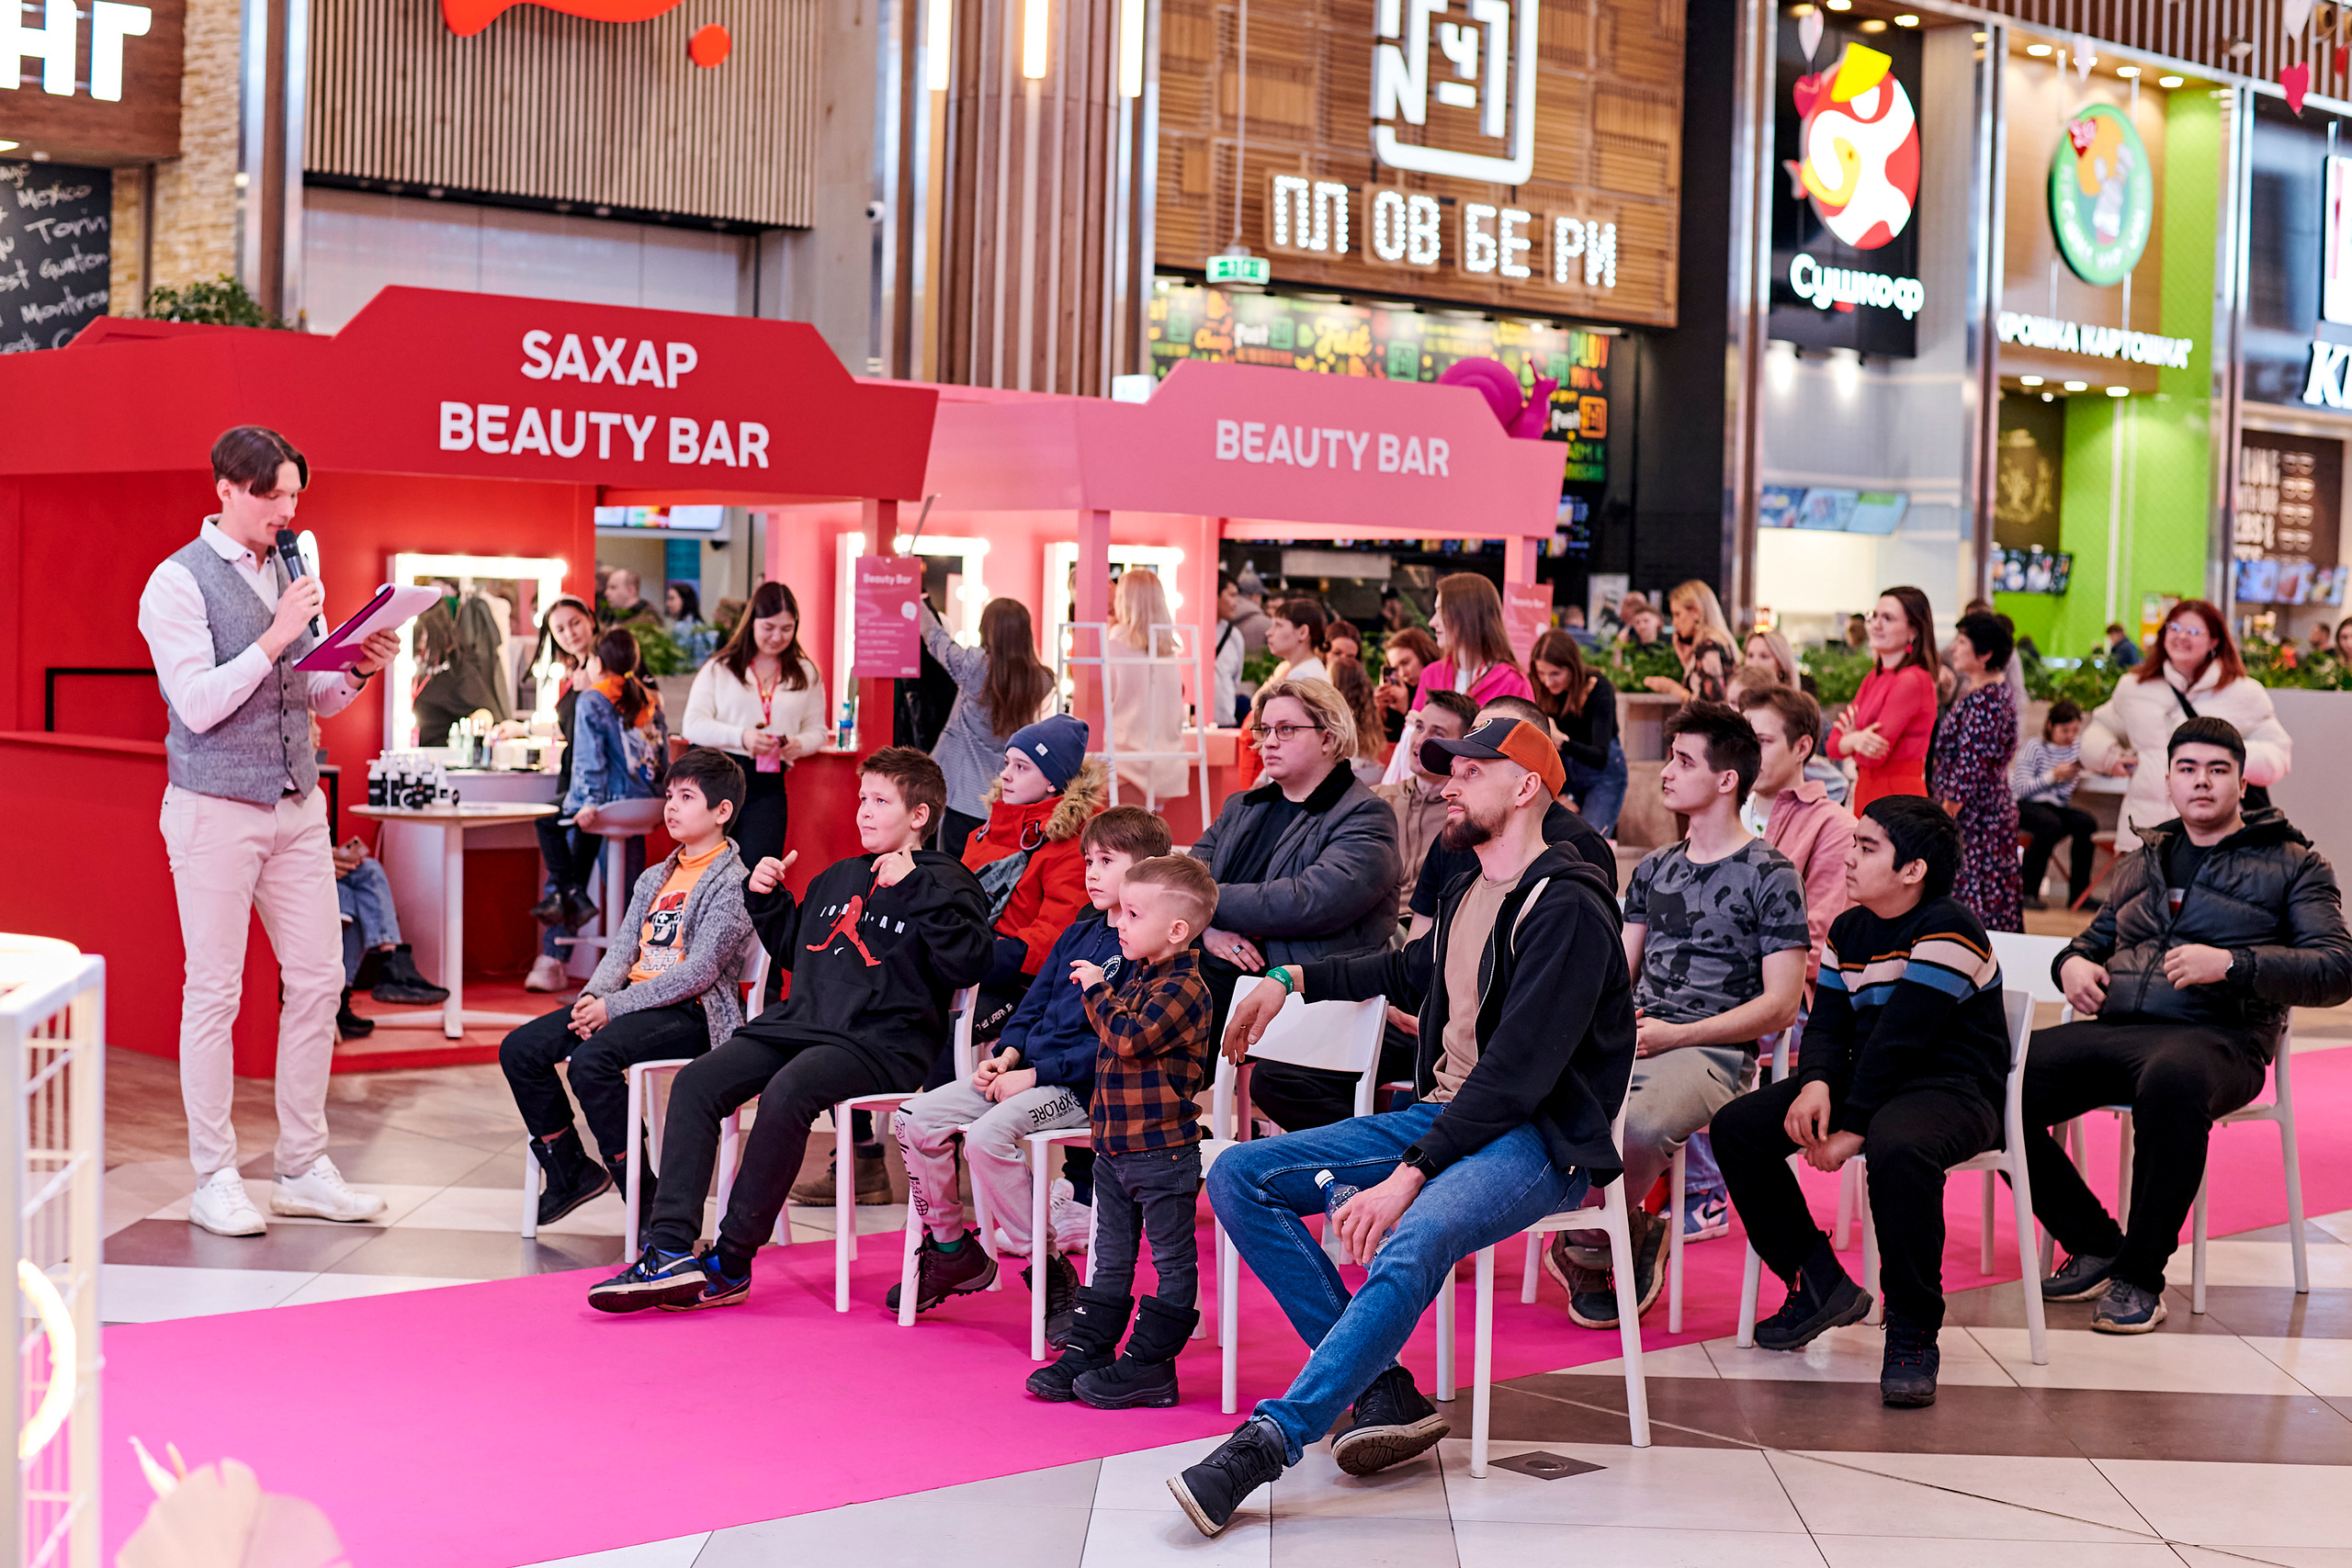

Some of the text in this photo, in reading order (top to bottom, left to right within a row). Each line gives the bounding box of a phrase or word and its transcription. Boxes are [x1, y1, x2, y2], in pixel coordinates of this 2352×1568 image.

[1790, 253, 1925, 321] Сушкоф
[440, 401, 770, 468] BEAUTY BAR
[1216, 419, 1450, 477] BEAUTY BAR
[863, 572, 895, 586] Beauty
